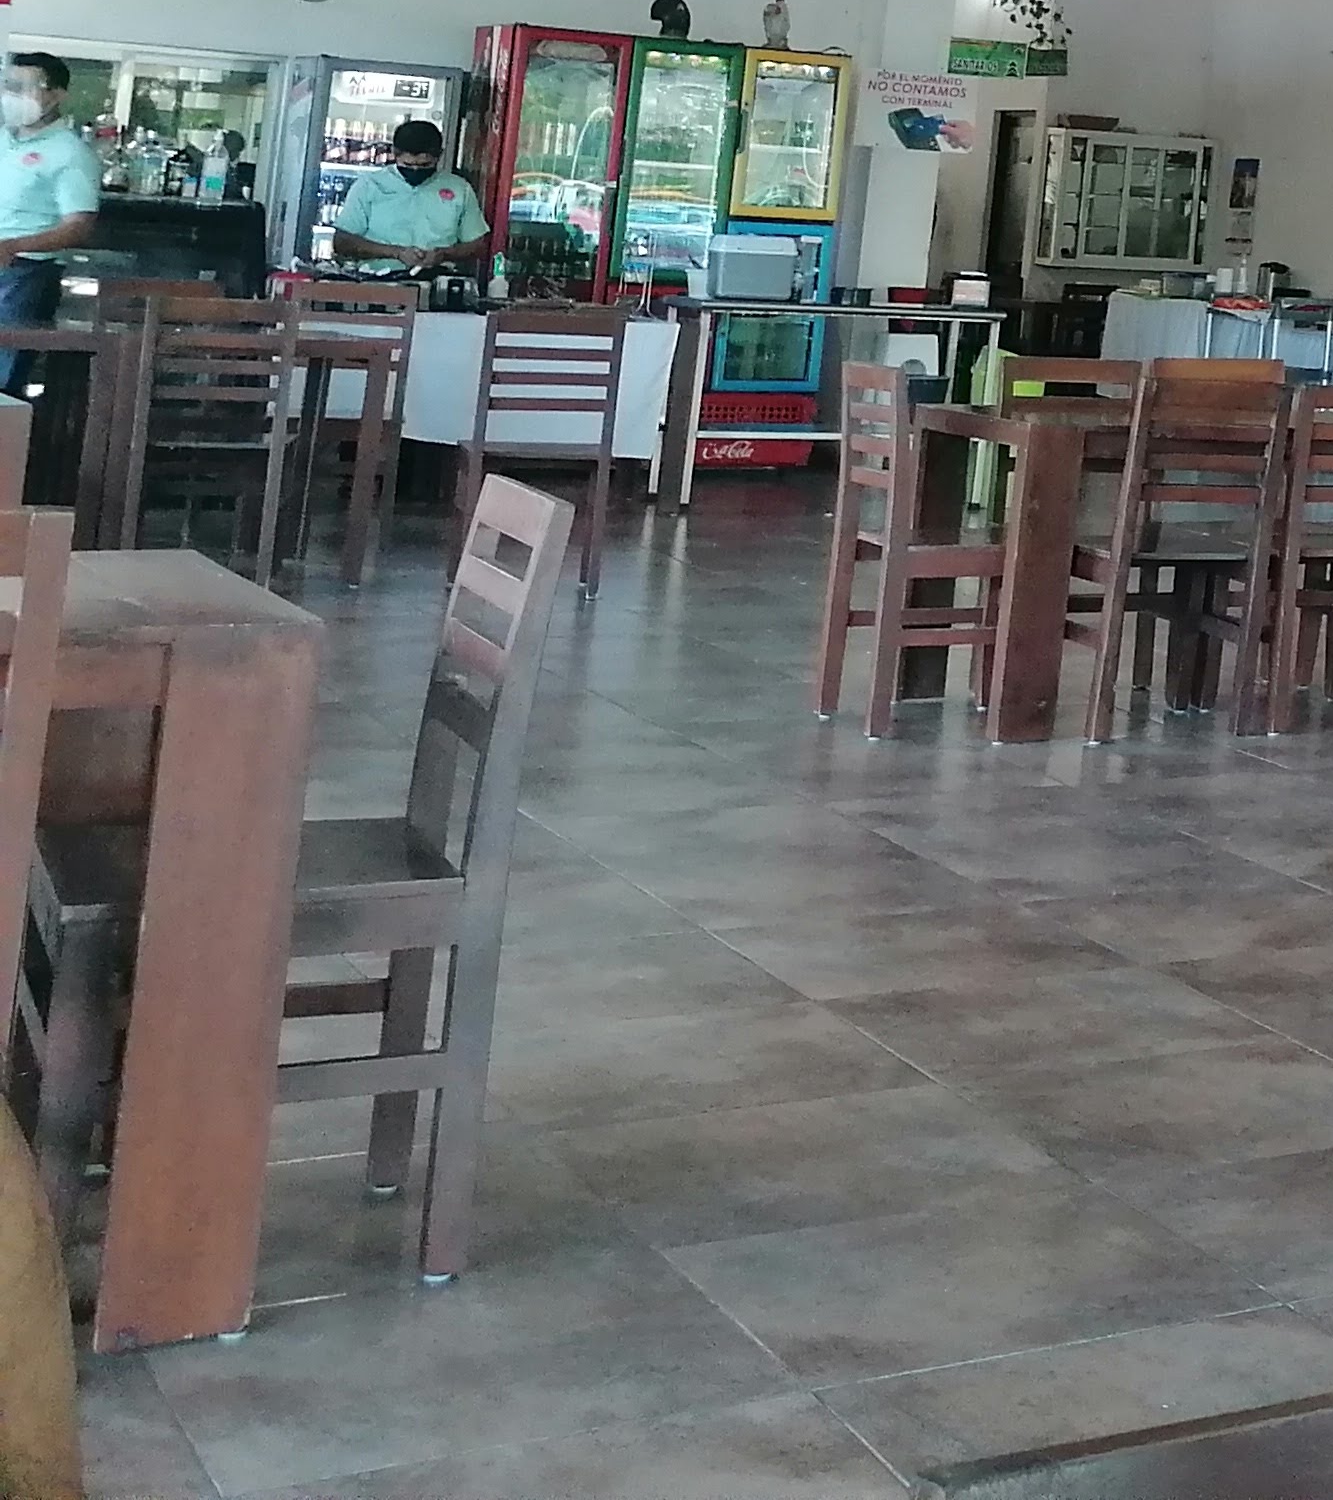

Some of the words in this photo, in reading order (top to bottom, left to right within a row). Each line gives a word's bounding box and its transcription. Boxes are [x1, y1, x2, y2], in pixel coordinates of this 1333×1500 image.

[952, 57, 999, 72] SANITARIOS
[877, 71, 897, 80] POR
[899, 73, 909, 81] EL
[912, 75, 963, 86] MOMENTO
[868, 80, 889, 91] NO
[892, 82, 967, 98] CONTAMOS
[881, 95, 905, 105] CON
[907, 97, 953, 109] TERMINAL
